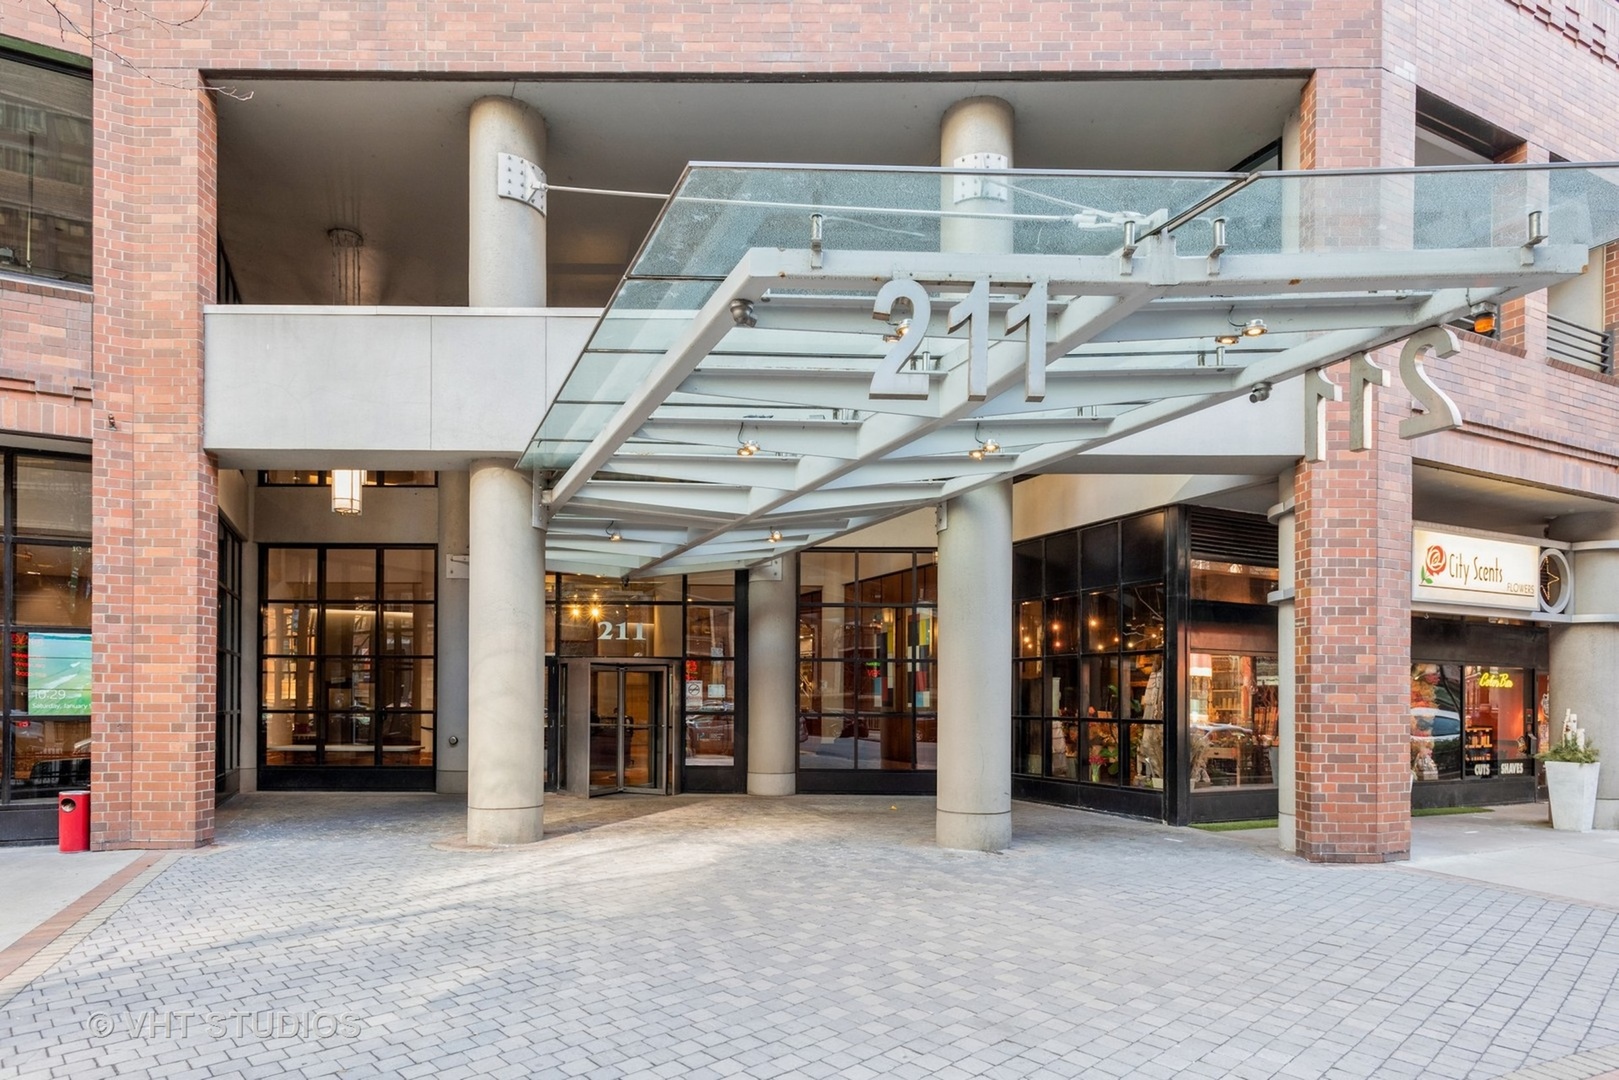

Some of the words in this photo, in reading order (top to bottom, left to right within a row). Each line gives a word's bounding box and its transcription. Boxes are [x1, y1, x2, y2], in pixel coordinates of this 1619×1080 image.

[869, 279, 1048, 402] 211
[1449, 553, 1470, 585] City
[1473, 556, 1503, 583] Scents
[1506, 583, 1535, 594] FLOWERS
[597, 621, 646, 640] 211
[34, 689, 66, 700] 10:29
[1474, 763, 1490, 776] CUTS
[1500, 762, 1524, 774] SHAVES
